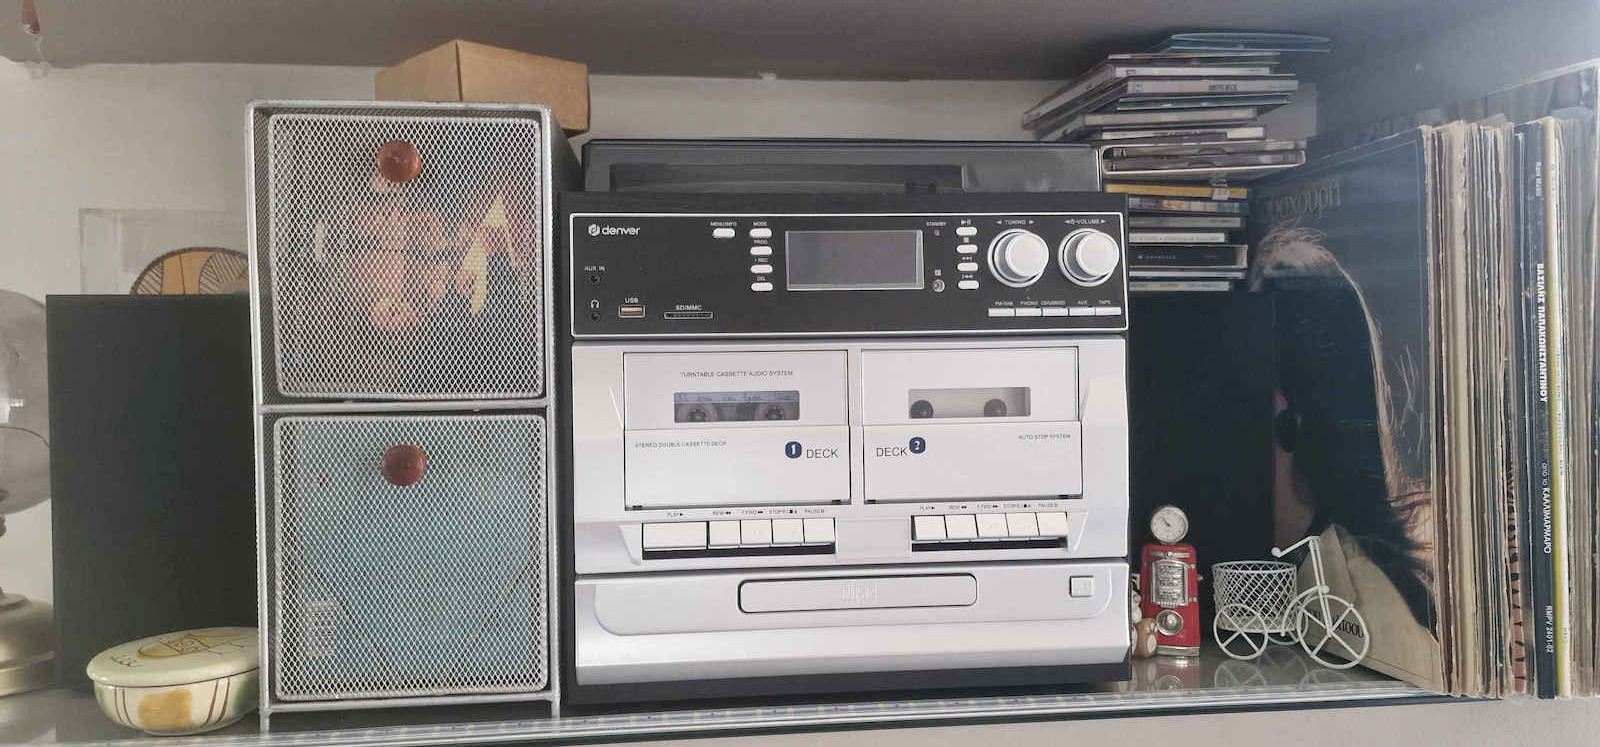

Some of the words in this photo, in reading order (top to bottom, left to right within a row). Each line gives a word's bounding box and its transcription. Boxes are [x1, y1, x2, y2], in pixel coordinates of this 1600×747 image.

[602, 225, 641, 236] denver
[806, 448, 839, 459] DECK
[876, 447, 908, 458] DECK
[1542, 487, 1552, 554] ΚΑΛΛΙΜΑΡΜΑΡΟ
[1545, 604, 1554, 625] RMPV
